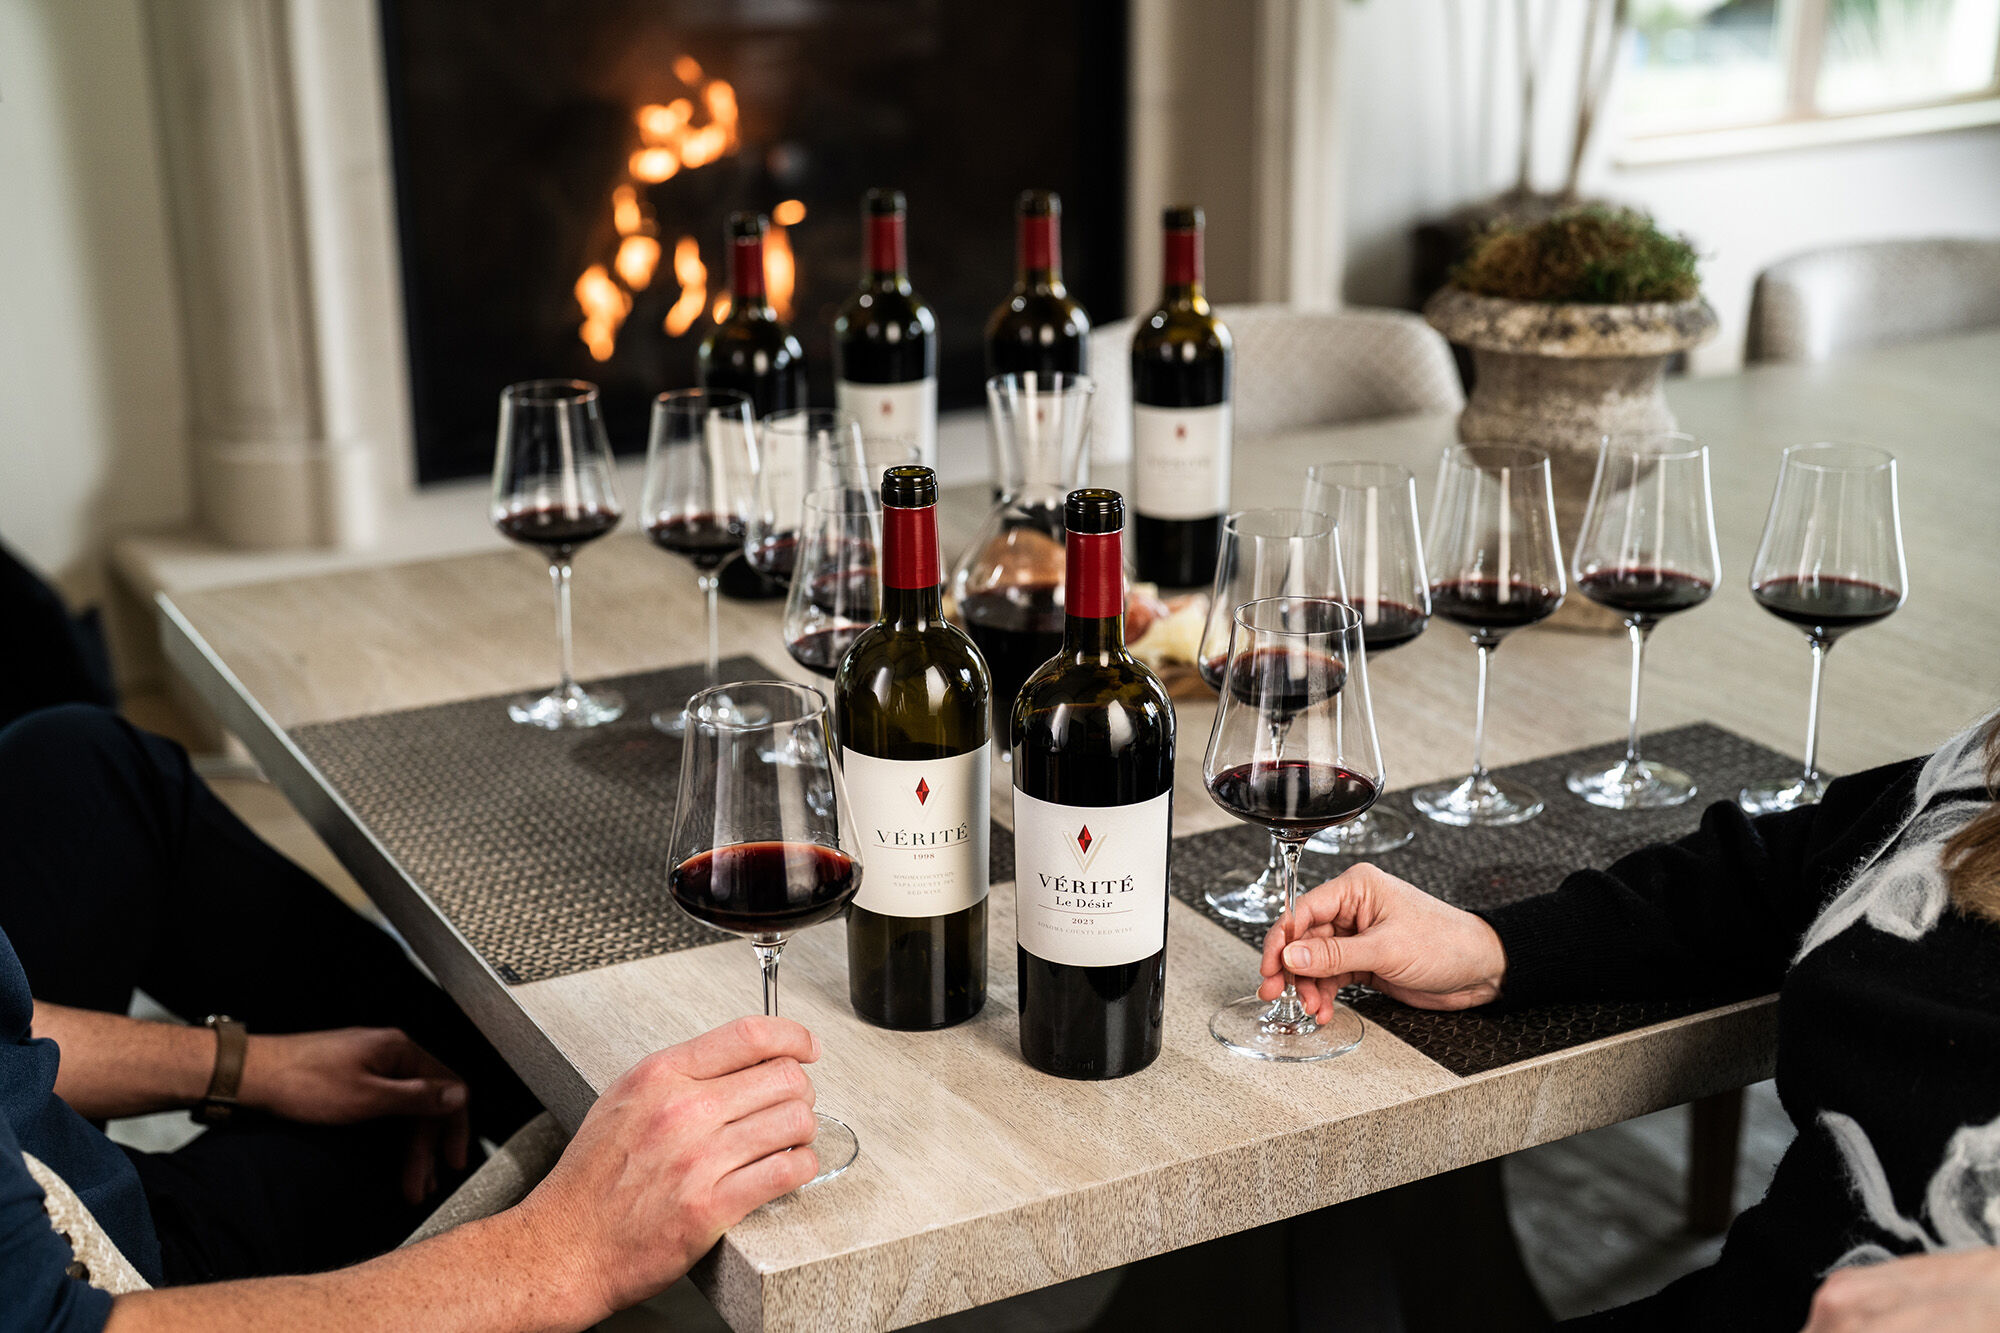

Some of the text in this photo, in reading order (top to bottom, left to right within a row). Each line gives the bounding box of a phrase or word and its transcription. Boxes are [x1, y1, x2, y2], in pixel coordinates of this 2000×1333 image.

[875, 822, 968, 846] VÉRITÉ
[1037, 872, 1134, 895] VÉRITÉ
[1055, 896, 1113, 909] Le Désir
[1037, 921, 1064, 933] SONOMA
[1065, 927, 1094, 935] COUNTY
[1072, 917, 1095, 925] 2023
